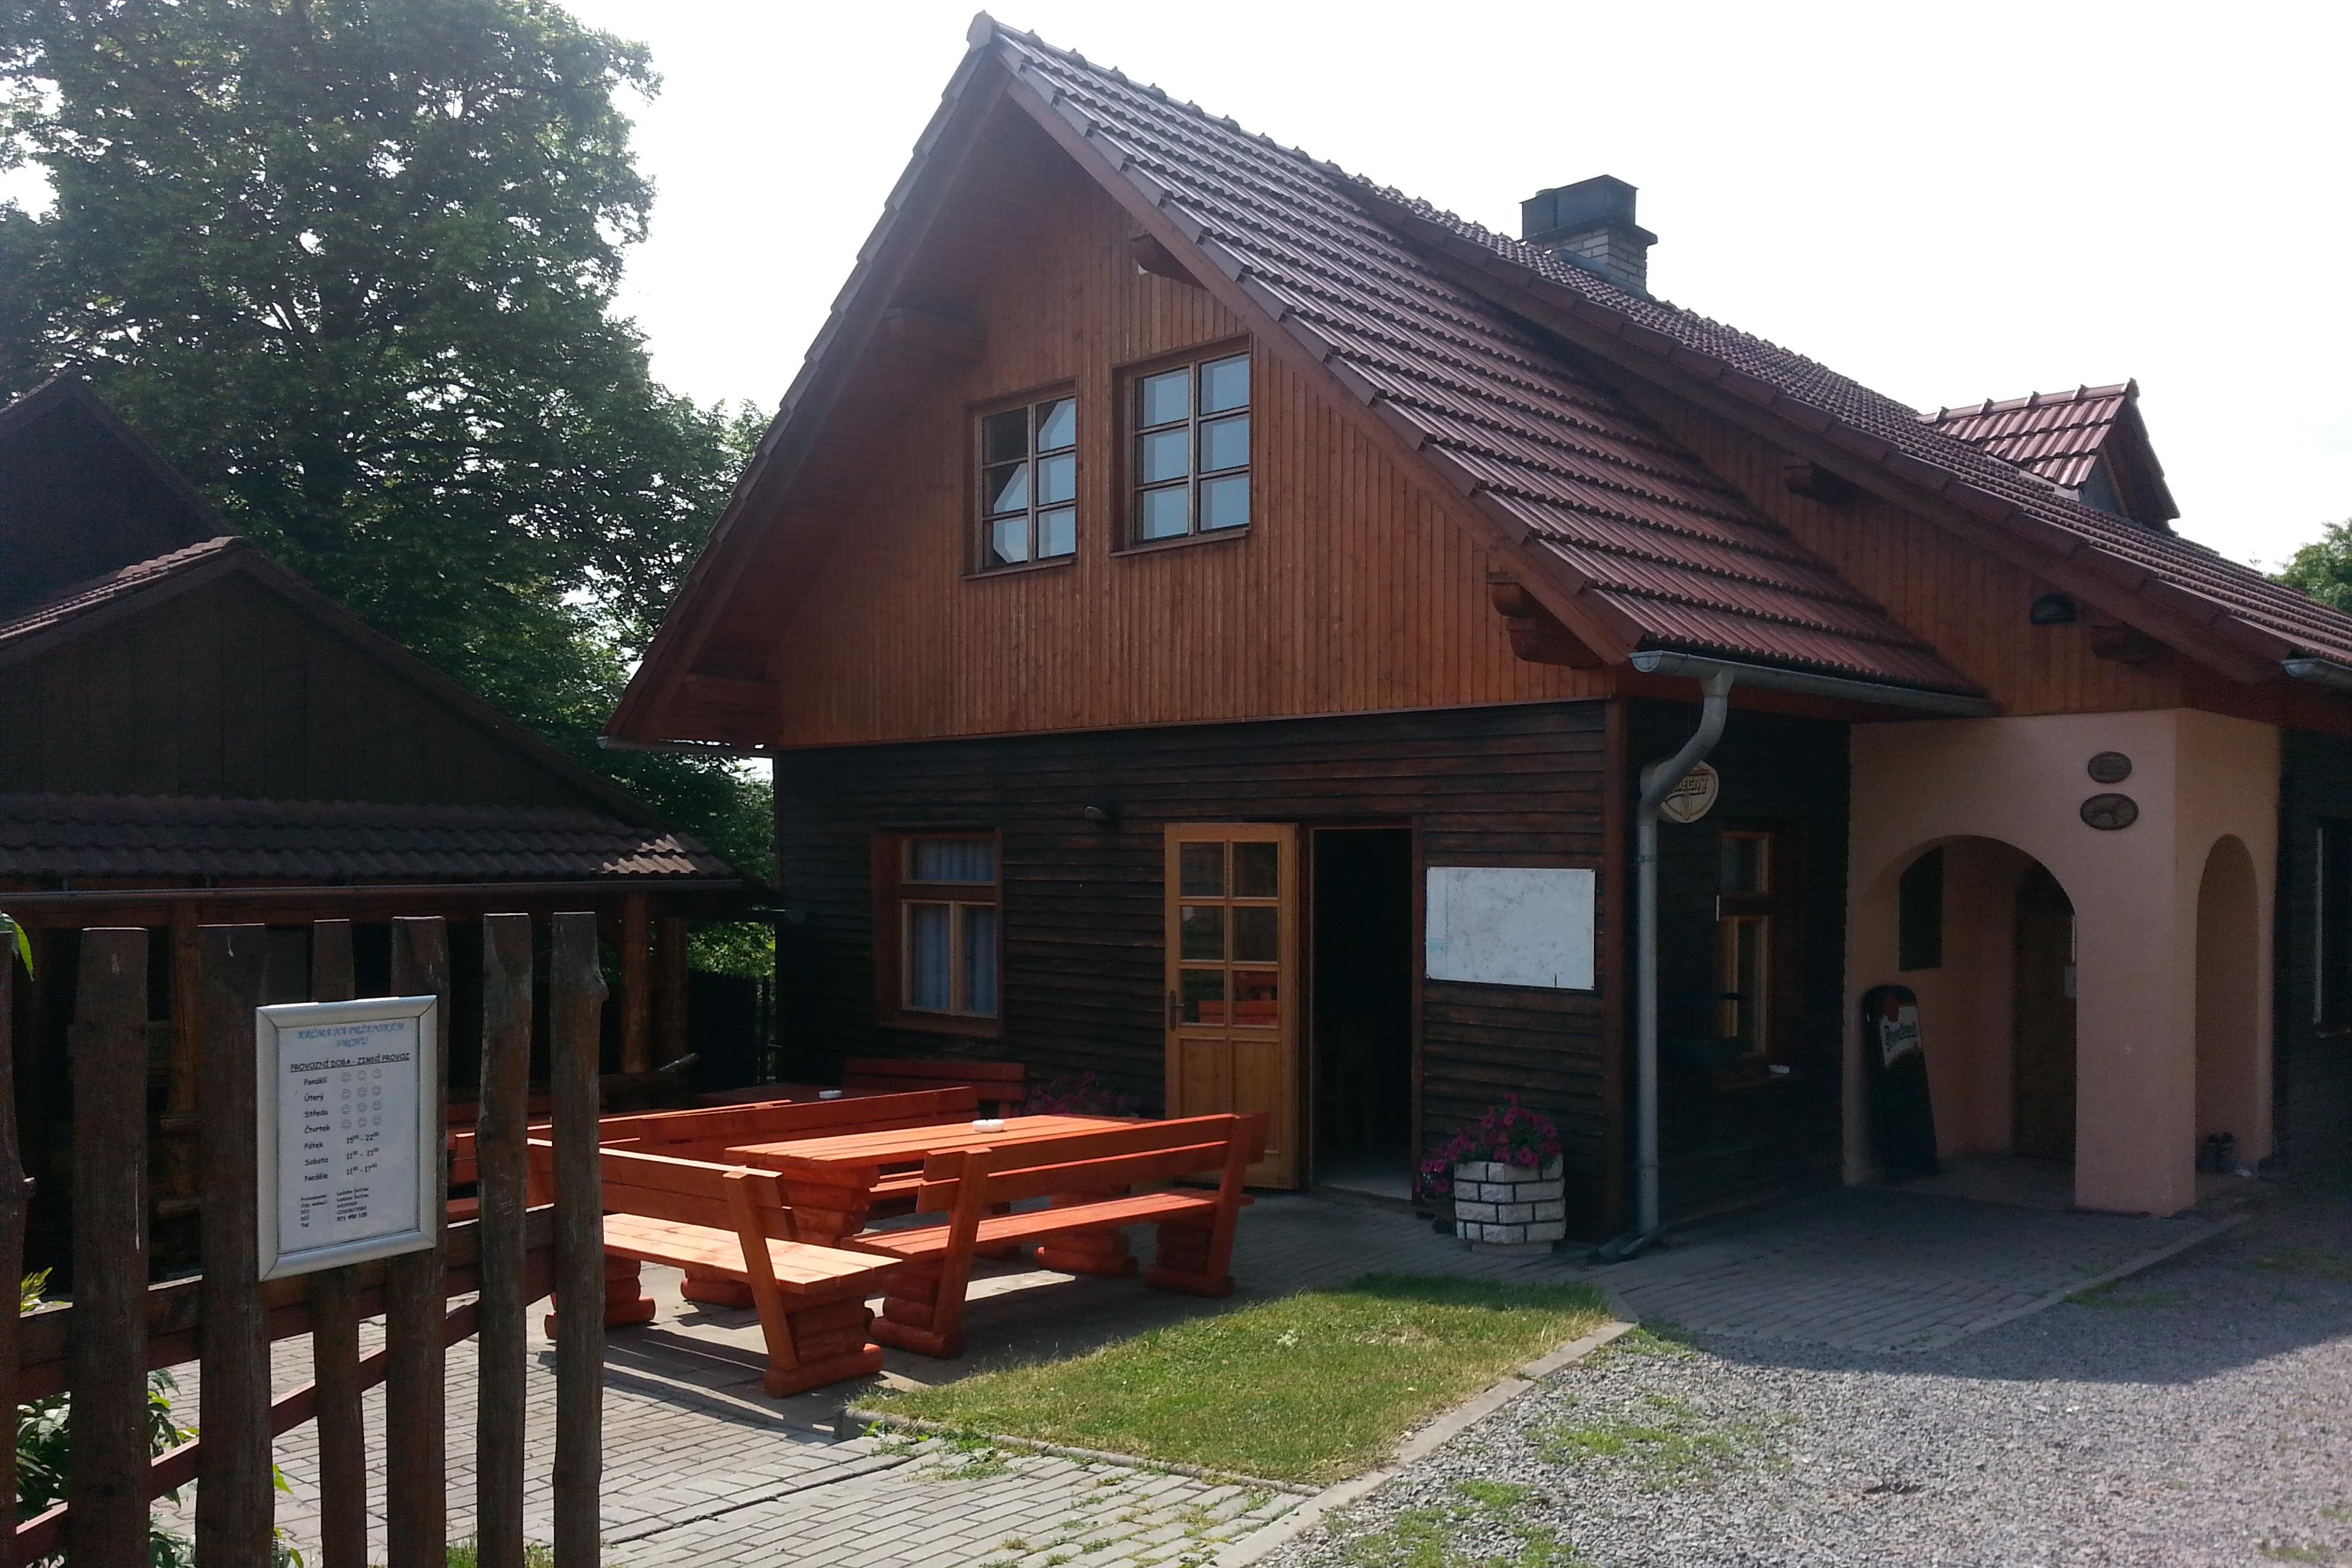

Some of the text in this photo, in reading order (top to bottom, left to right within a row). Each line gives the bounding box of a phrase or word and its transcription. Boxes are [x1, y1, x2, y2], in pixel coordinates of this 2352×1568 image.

[290, 1059, 329, 1072] PROVOZNÍ
[331, 1059, 351, 1068] DOBA
[357, 1054, 380, 1065] ZIMNÍ
[382, 1053, 410, 1063] PROVOZ
[303, 1077, 328, 1086] Pondělí
[304, 1092, 324, 1102] Úterý
[303, 1125, 331, 1134] Čtvrtek
[304, 1141, 324, 1150] Pátek
[304, 1157, 329, 1167] Sobota
[304, 1173, 329, 1182] Neděle
